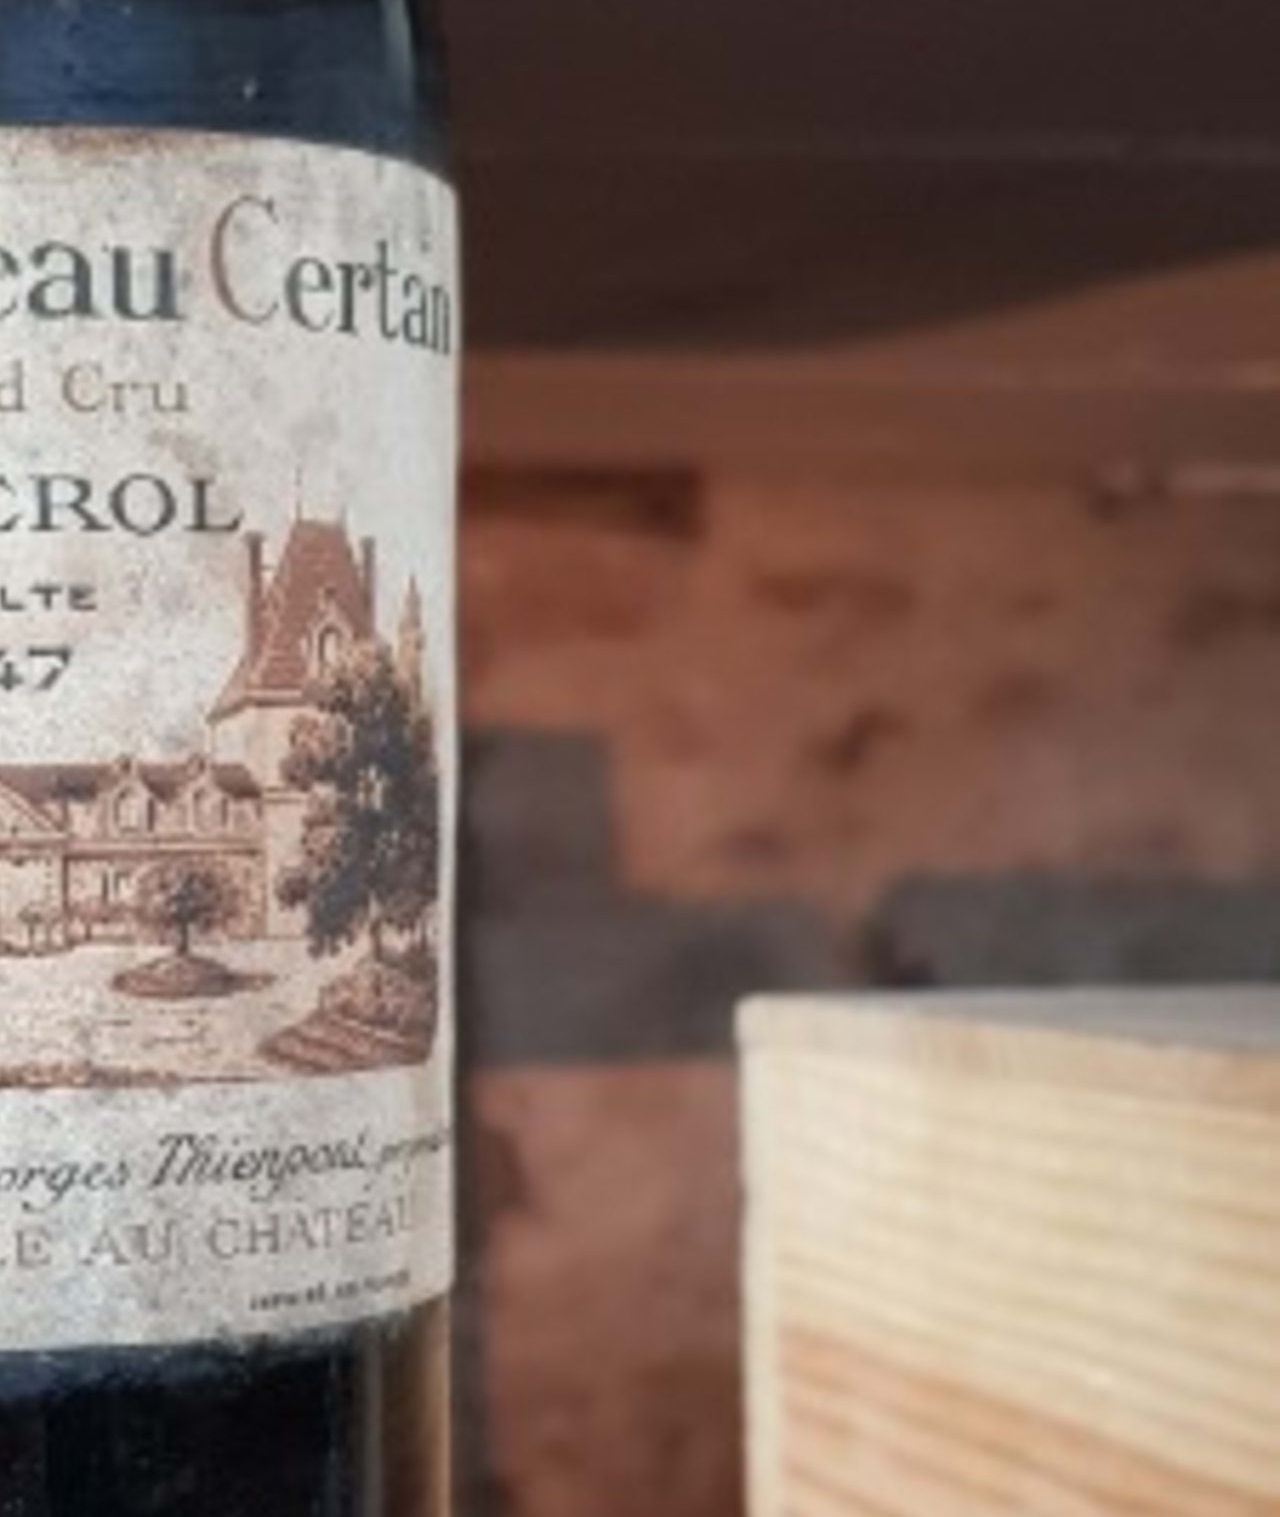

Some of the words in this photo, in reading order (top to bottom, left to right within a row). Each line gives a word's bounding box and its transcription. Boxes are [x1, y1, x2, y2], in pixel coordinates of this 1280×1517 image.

[208, 195, 451, 356] Certan
[61, 362, 190, 413] Cru
[83, 1221, 176, 1267] AU
